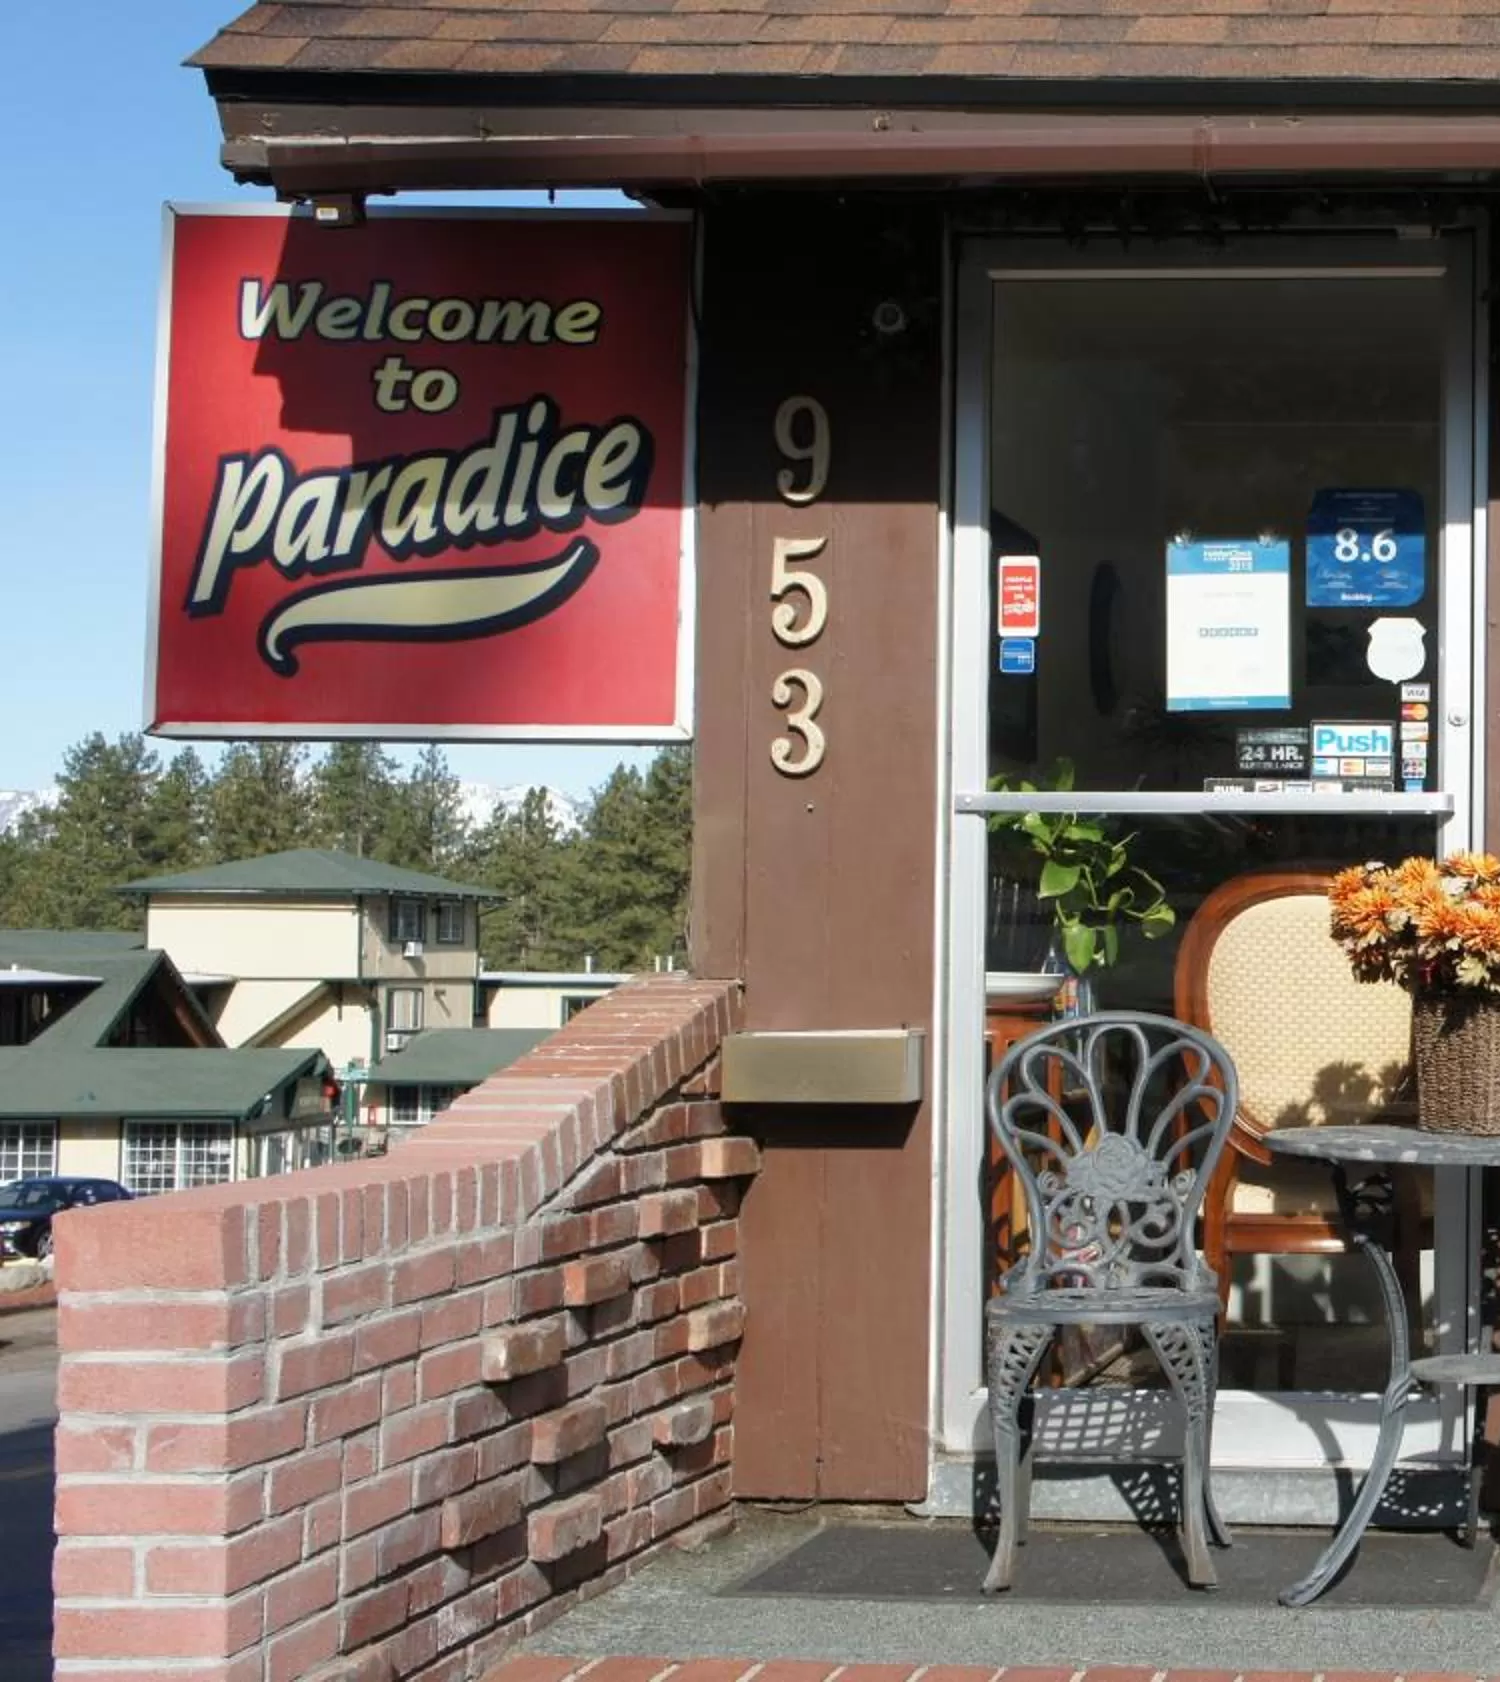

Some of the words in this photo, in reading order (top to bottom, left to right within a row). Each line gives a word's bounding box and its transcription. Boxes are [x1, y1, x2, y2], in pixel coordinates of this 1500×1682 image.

[237, 278, 603, 346] Welcome
[372, 355, 461, 414] to
[1334, 527, 1398, 562] 8.6
[1239, 744, 1265, 761] 24
[1271, 744, 1304, 761] HR.
[1315, 727, 1389, 753] Push
